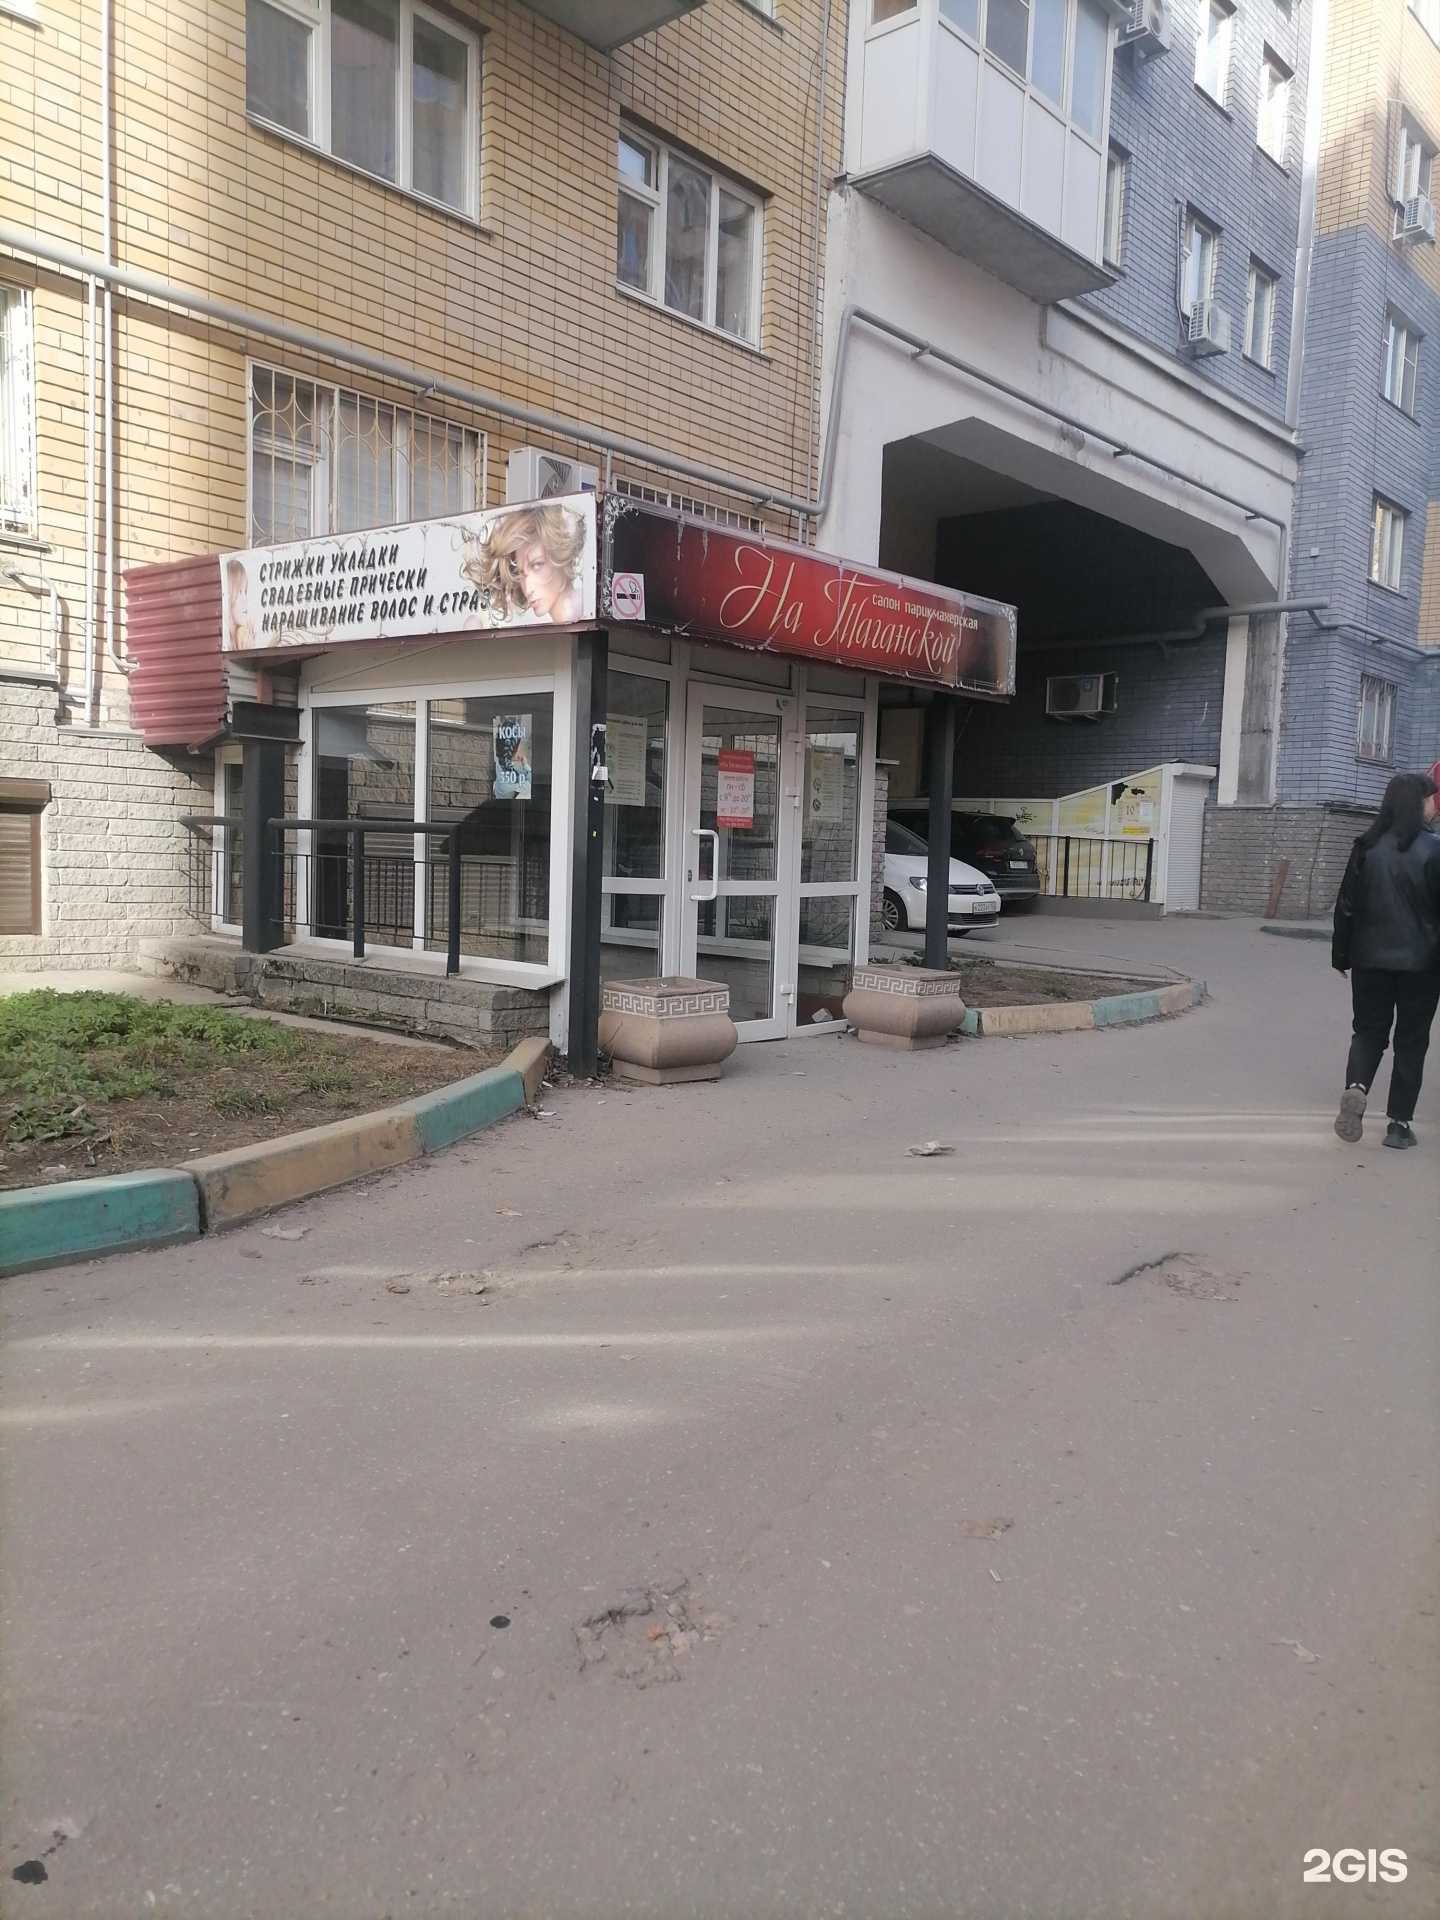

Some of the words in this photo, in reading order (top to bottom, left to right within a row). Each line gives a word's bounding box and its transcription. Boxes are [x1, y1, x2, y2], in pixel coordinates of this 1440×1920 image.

[260, 555, 324, 582] СТРИЖКИ
[330, 544, 399, 573] УКЛАДКИ
[261, 578, 345, 608] СВАДЕБНЫЕ
[350, 567, 428, 597] ПРИЧЕСКИ
[872, 592, 901, 612] салон
[261, 602, 365, 632] НАРАЩИВАНИЕ
[370, 596, 418, 621] ВОЛОС
[423, 594, 434, 616] И
[719, 545, 804, 631] На
[814, 574, 958, 675] Таганской
[499, 726, 526, 740] КОСЫ
